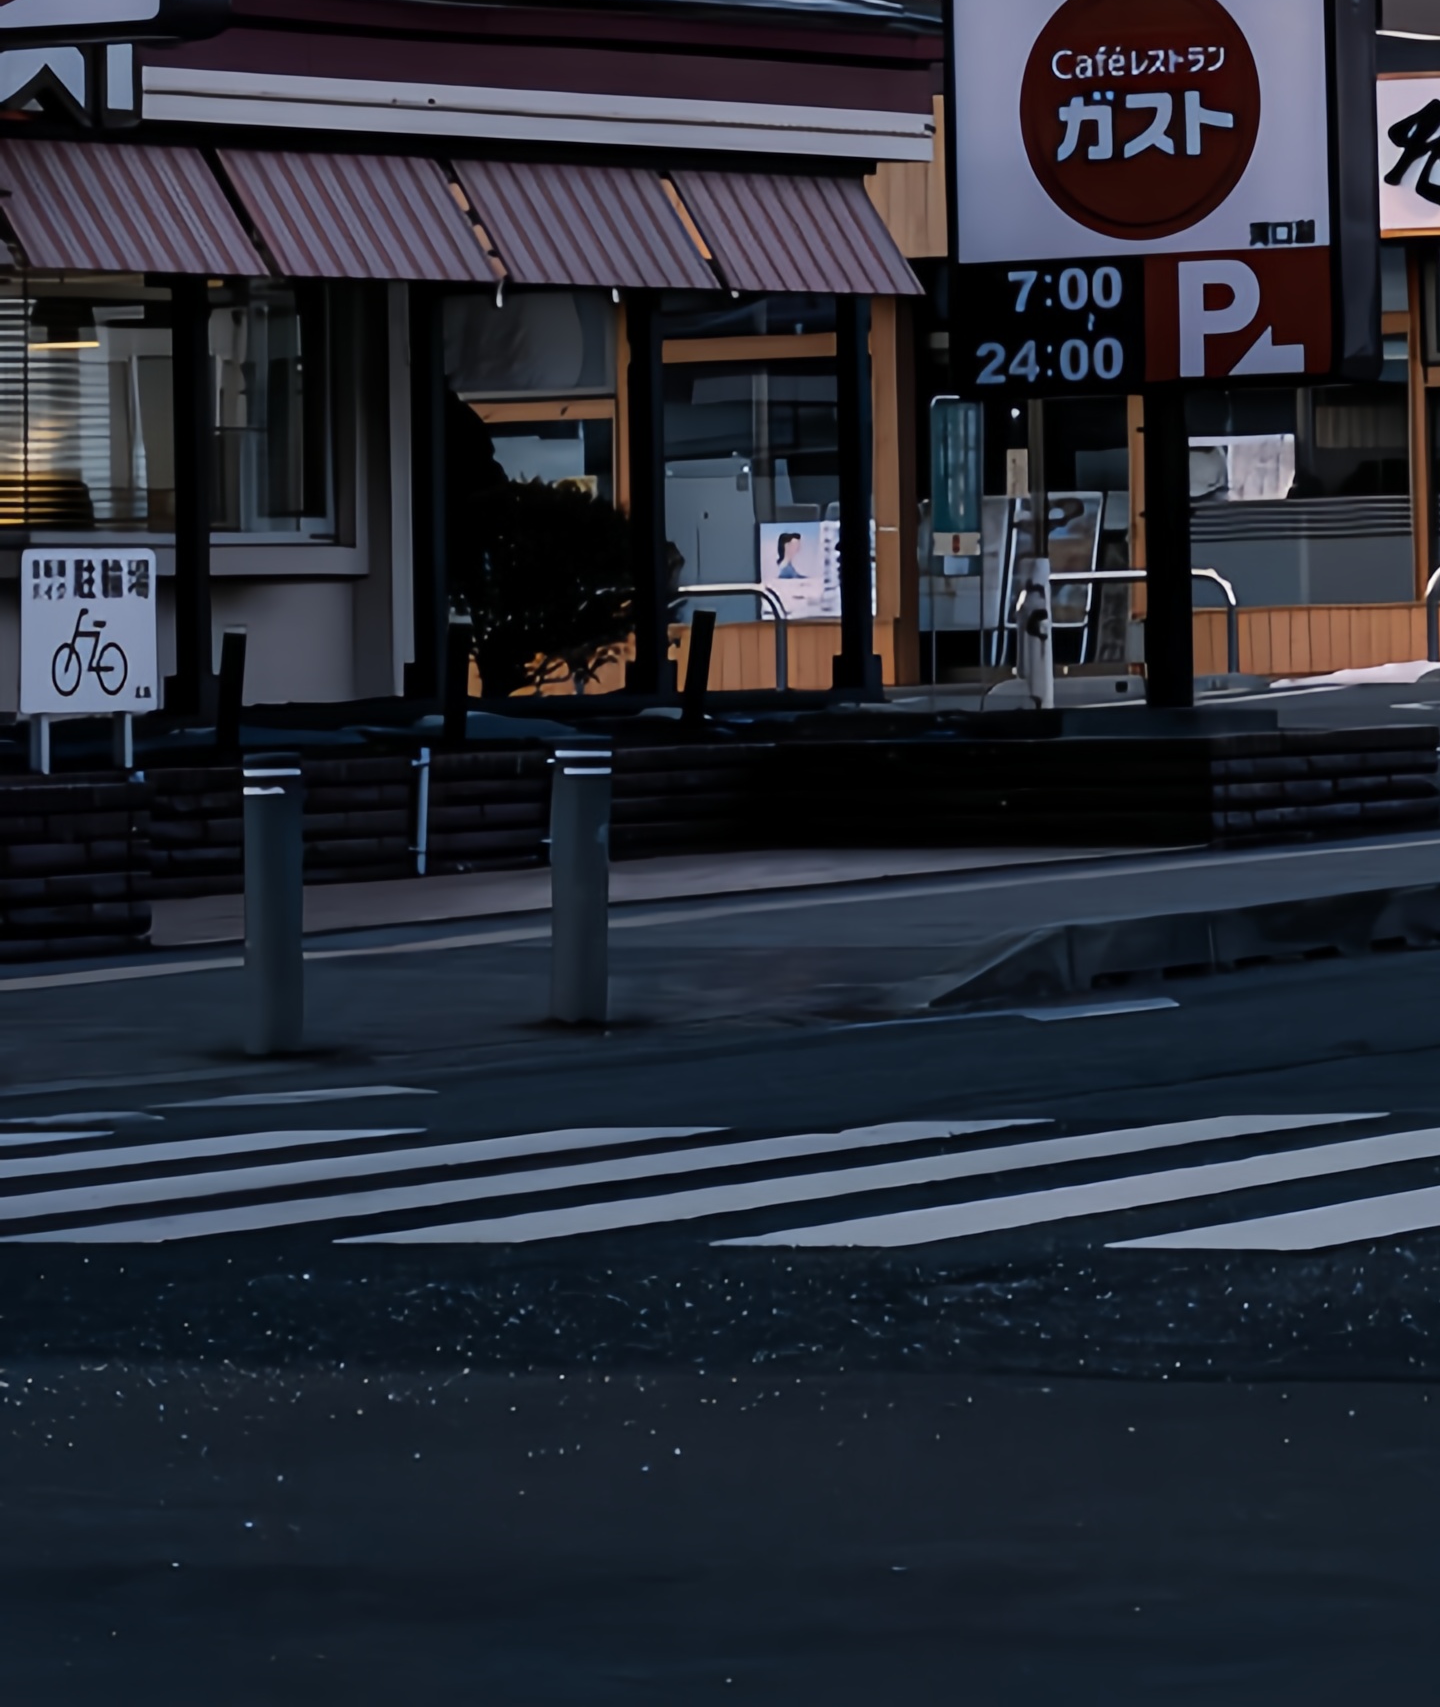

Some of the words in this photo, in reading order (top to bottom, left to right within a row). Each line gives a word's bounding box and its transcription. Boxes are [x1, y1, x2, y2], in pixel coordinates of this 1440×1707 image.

[1056, 89, 1234, 163] ガスト
[1007, 265, 1123, 313] 7:00
[1177, 258, 1261, 378] P
[975, 336, 1124, 385] 24:00
